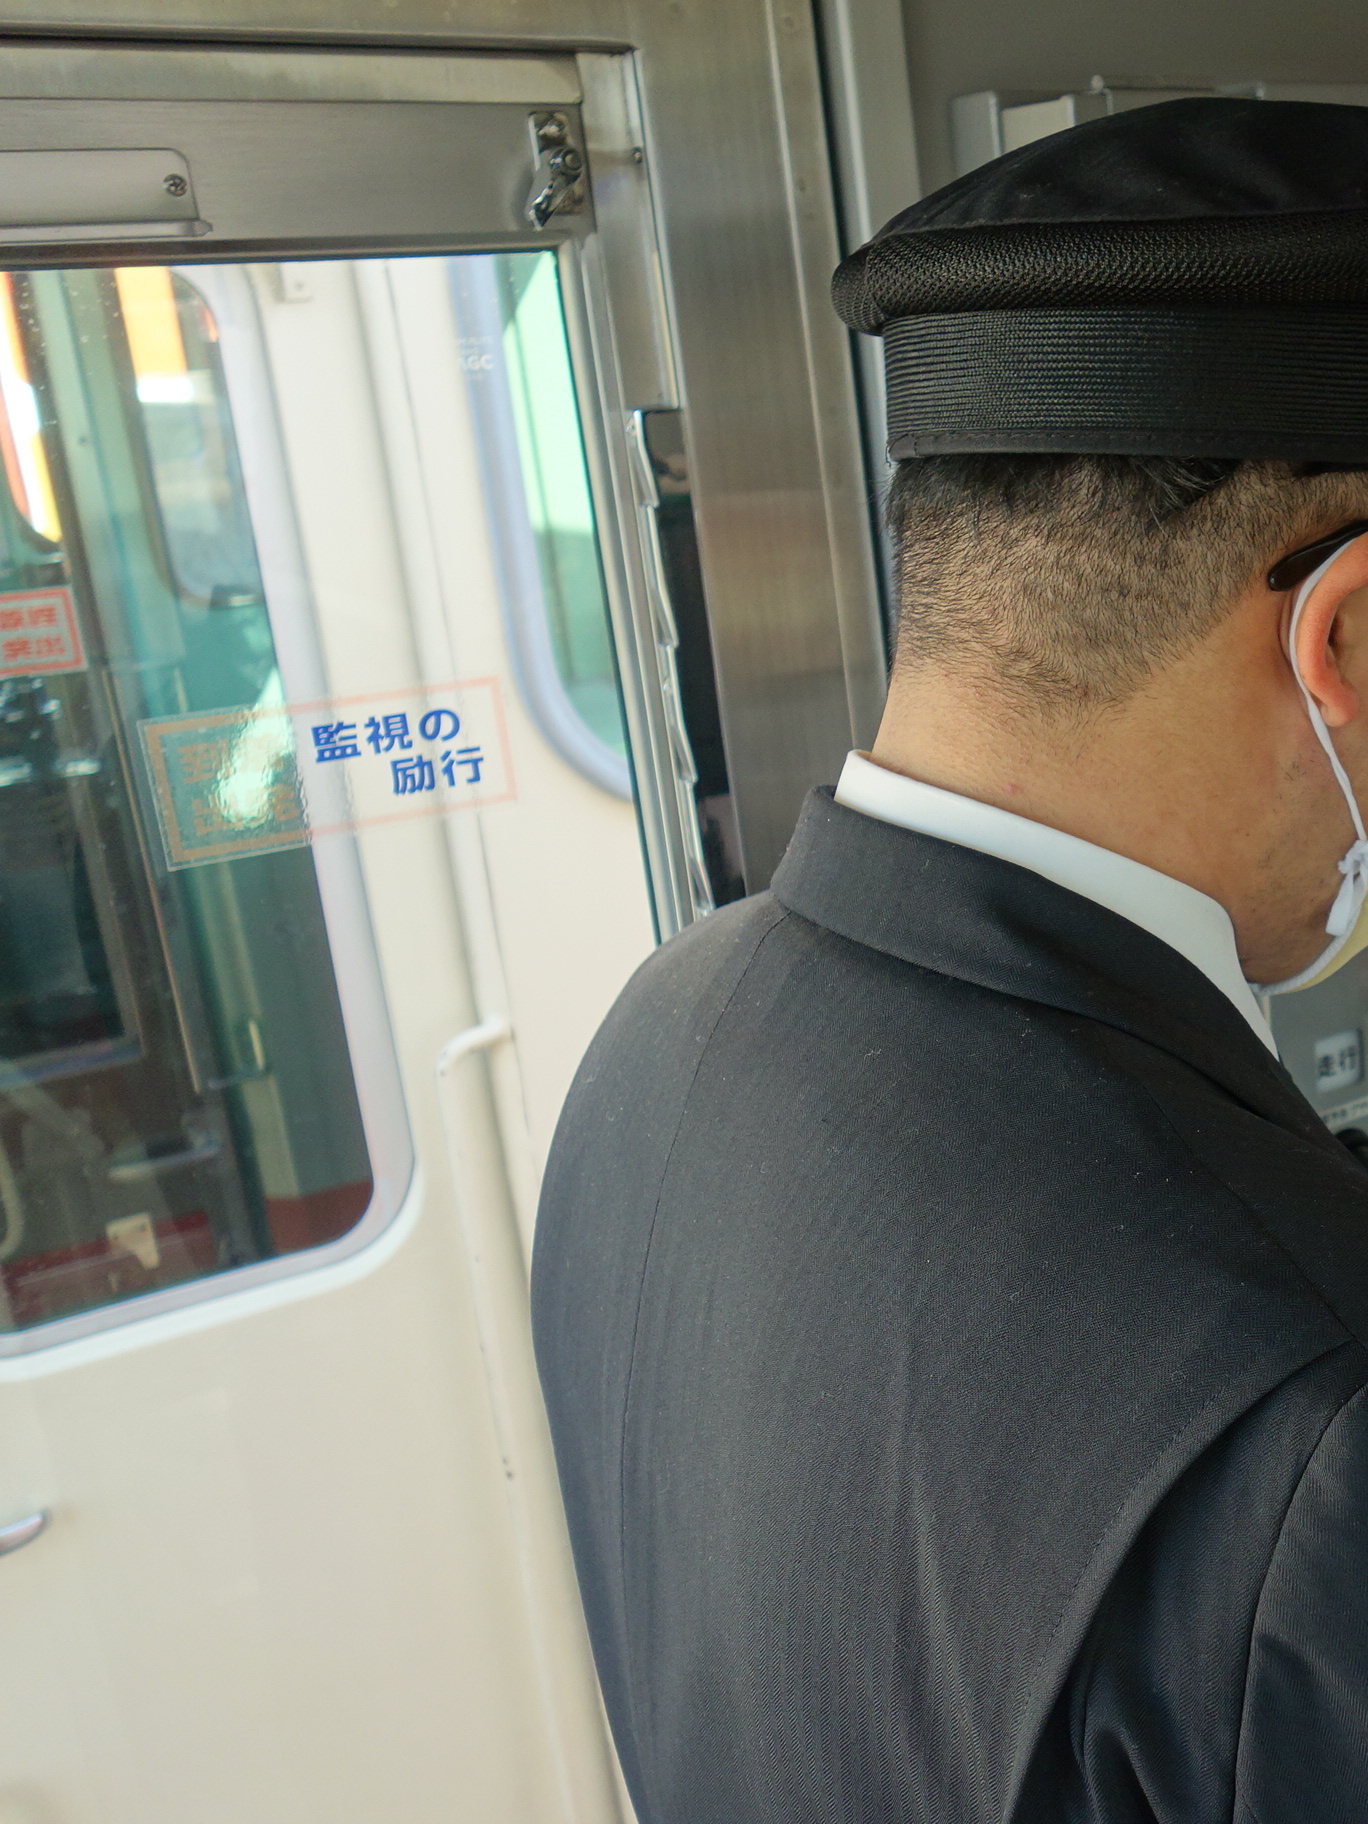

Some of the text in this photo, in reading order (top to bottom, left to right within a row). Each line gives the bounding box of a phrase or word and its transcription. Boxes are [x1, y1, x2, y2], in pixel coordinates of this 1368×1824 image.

[311, 709, 460, 763] 監視の
[390, 747, 484, 795] 励行
